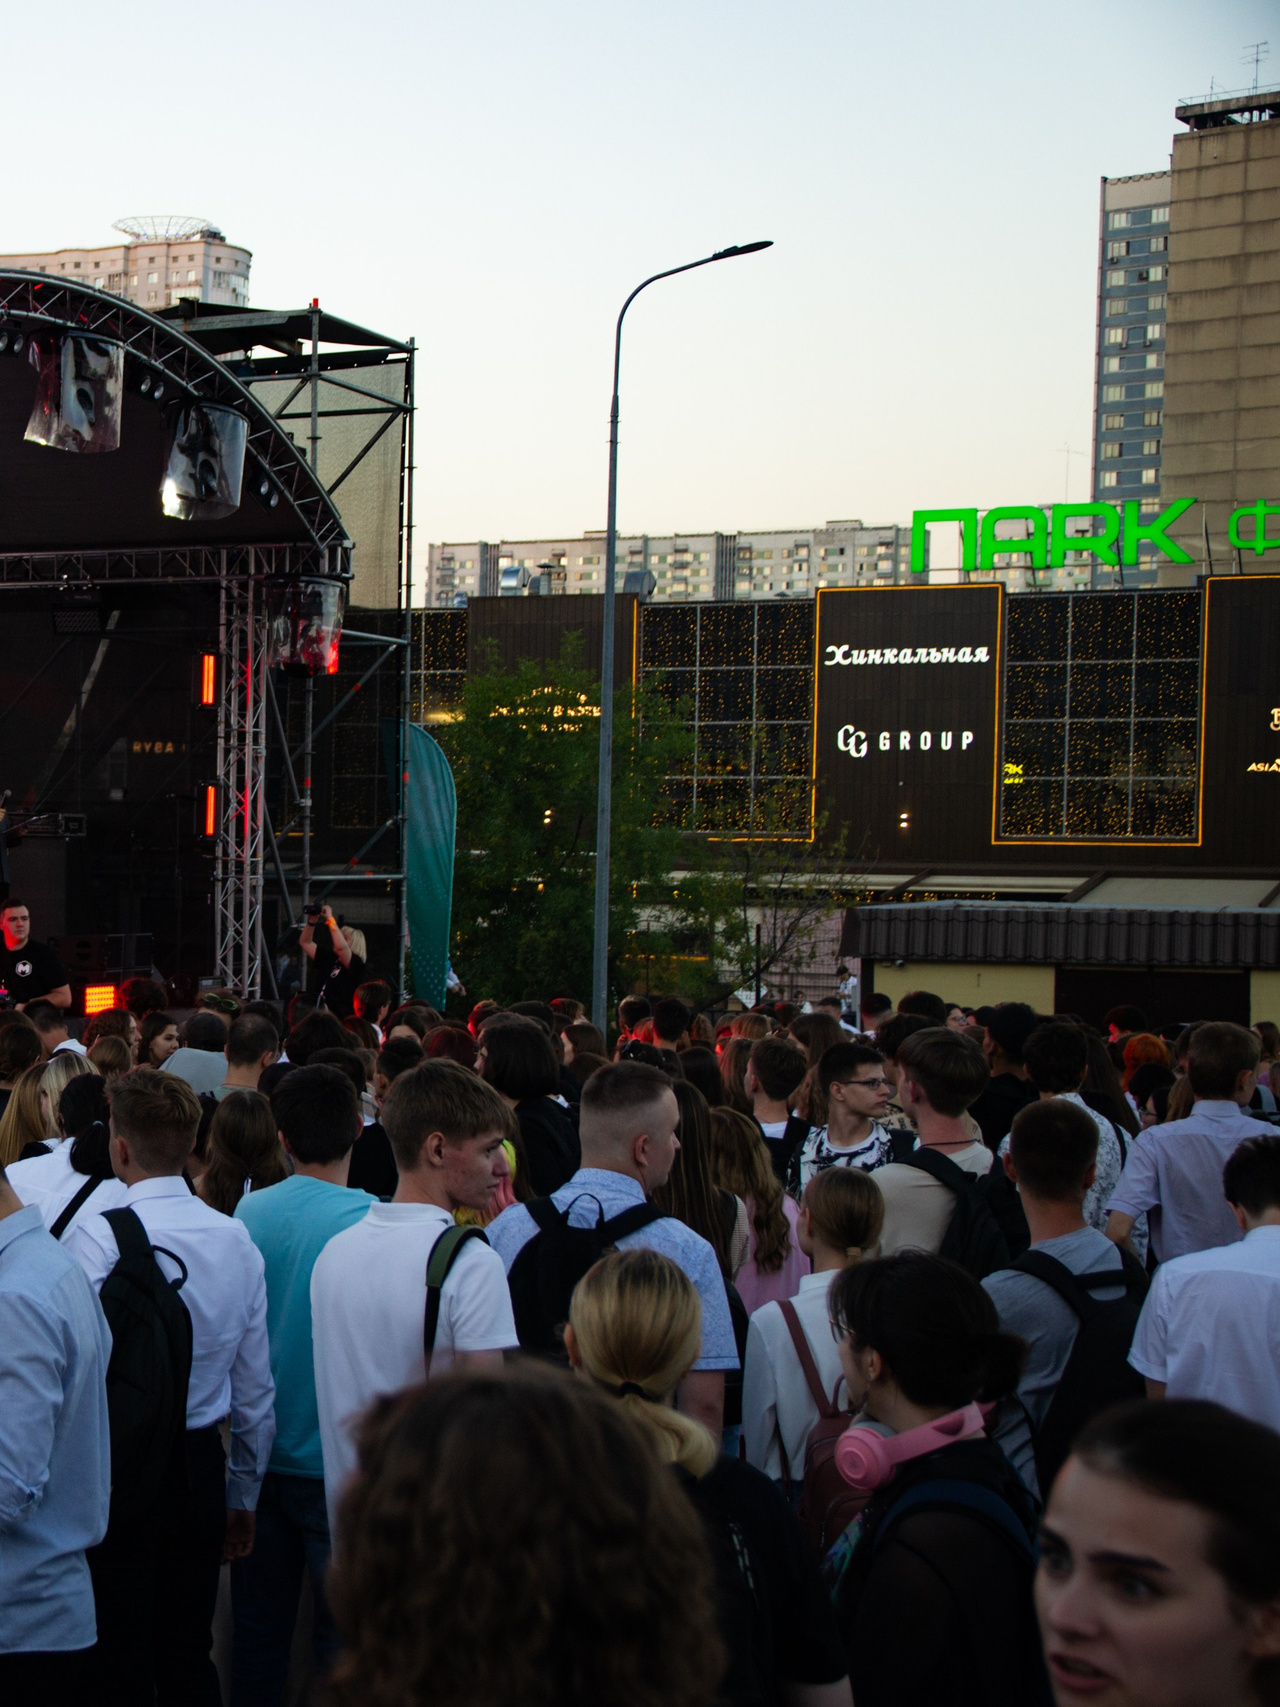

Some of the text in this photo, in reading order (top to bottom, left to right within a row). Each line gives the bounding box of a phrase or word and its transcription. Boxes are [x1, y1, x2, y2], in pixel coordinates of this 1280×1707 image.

[824, 645, 990, 666] Хинкальная
[878, 731, 974, 751] GROUP
[1247, 762, 1280, 772] ASIA
